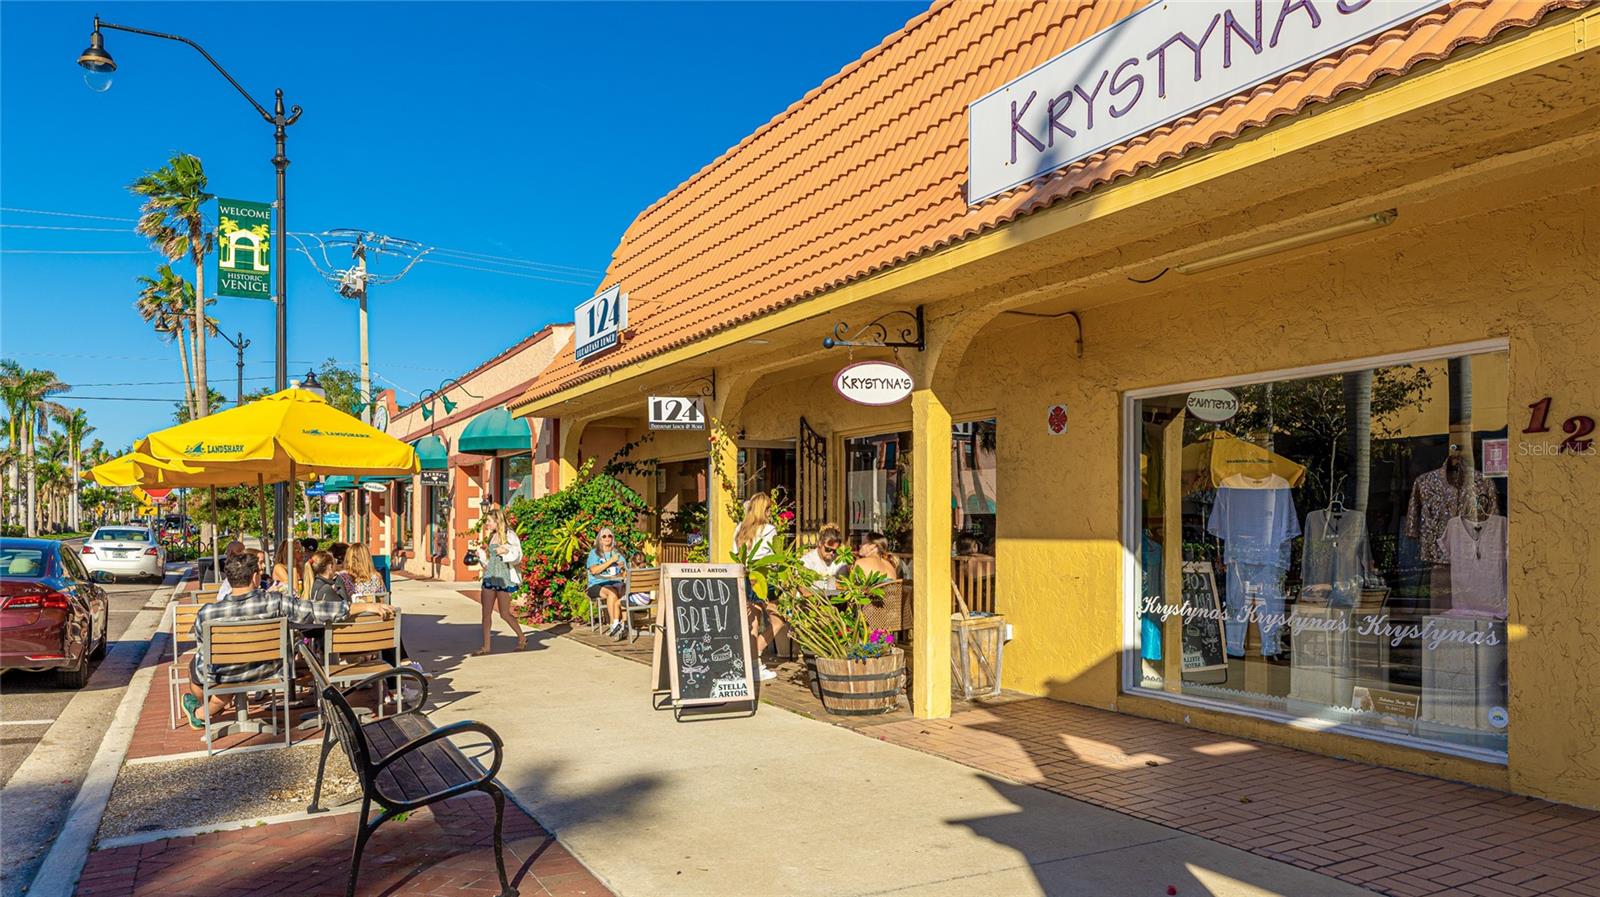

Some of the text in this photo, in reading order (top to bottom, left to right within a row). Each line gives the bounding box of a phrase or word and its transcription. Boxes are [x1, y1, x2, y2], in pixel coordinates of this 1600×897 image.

[1010, 0, 1372, 164] KRYSTYNA
[219, 205, 271, 220] WELCOME
[227, 272, 263, 283] HISTORIC
[221, 278, 269, 293] VENICE
[587, 290, 620, 338] 124
[841, 375, 912, 390] KRYSTYNA'S
[653, 400, 700, 421] 124
[207, 444, 244, 454] LANDSHARK
[677, 578, 731, 605] COLD
[676, 604, 729, 634] BREW
[1136, 595, 1229, 625] Krystyna's
[1237, 605, 1351, 635] Krystyna's
[1357, 614, 1501, 650] Krystyna's
[718, 683, 748, 691] STELLA
[718, 690, 749, 698] ARTOIS
